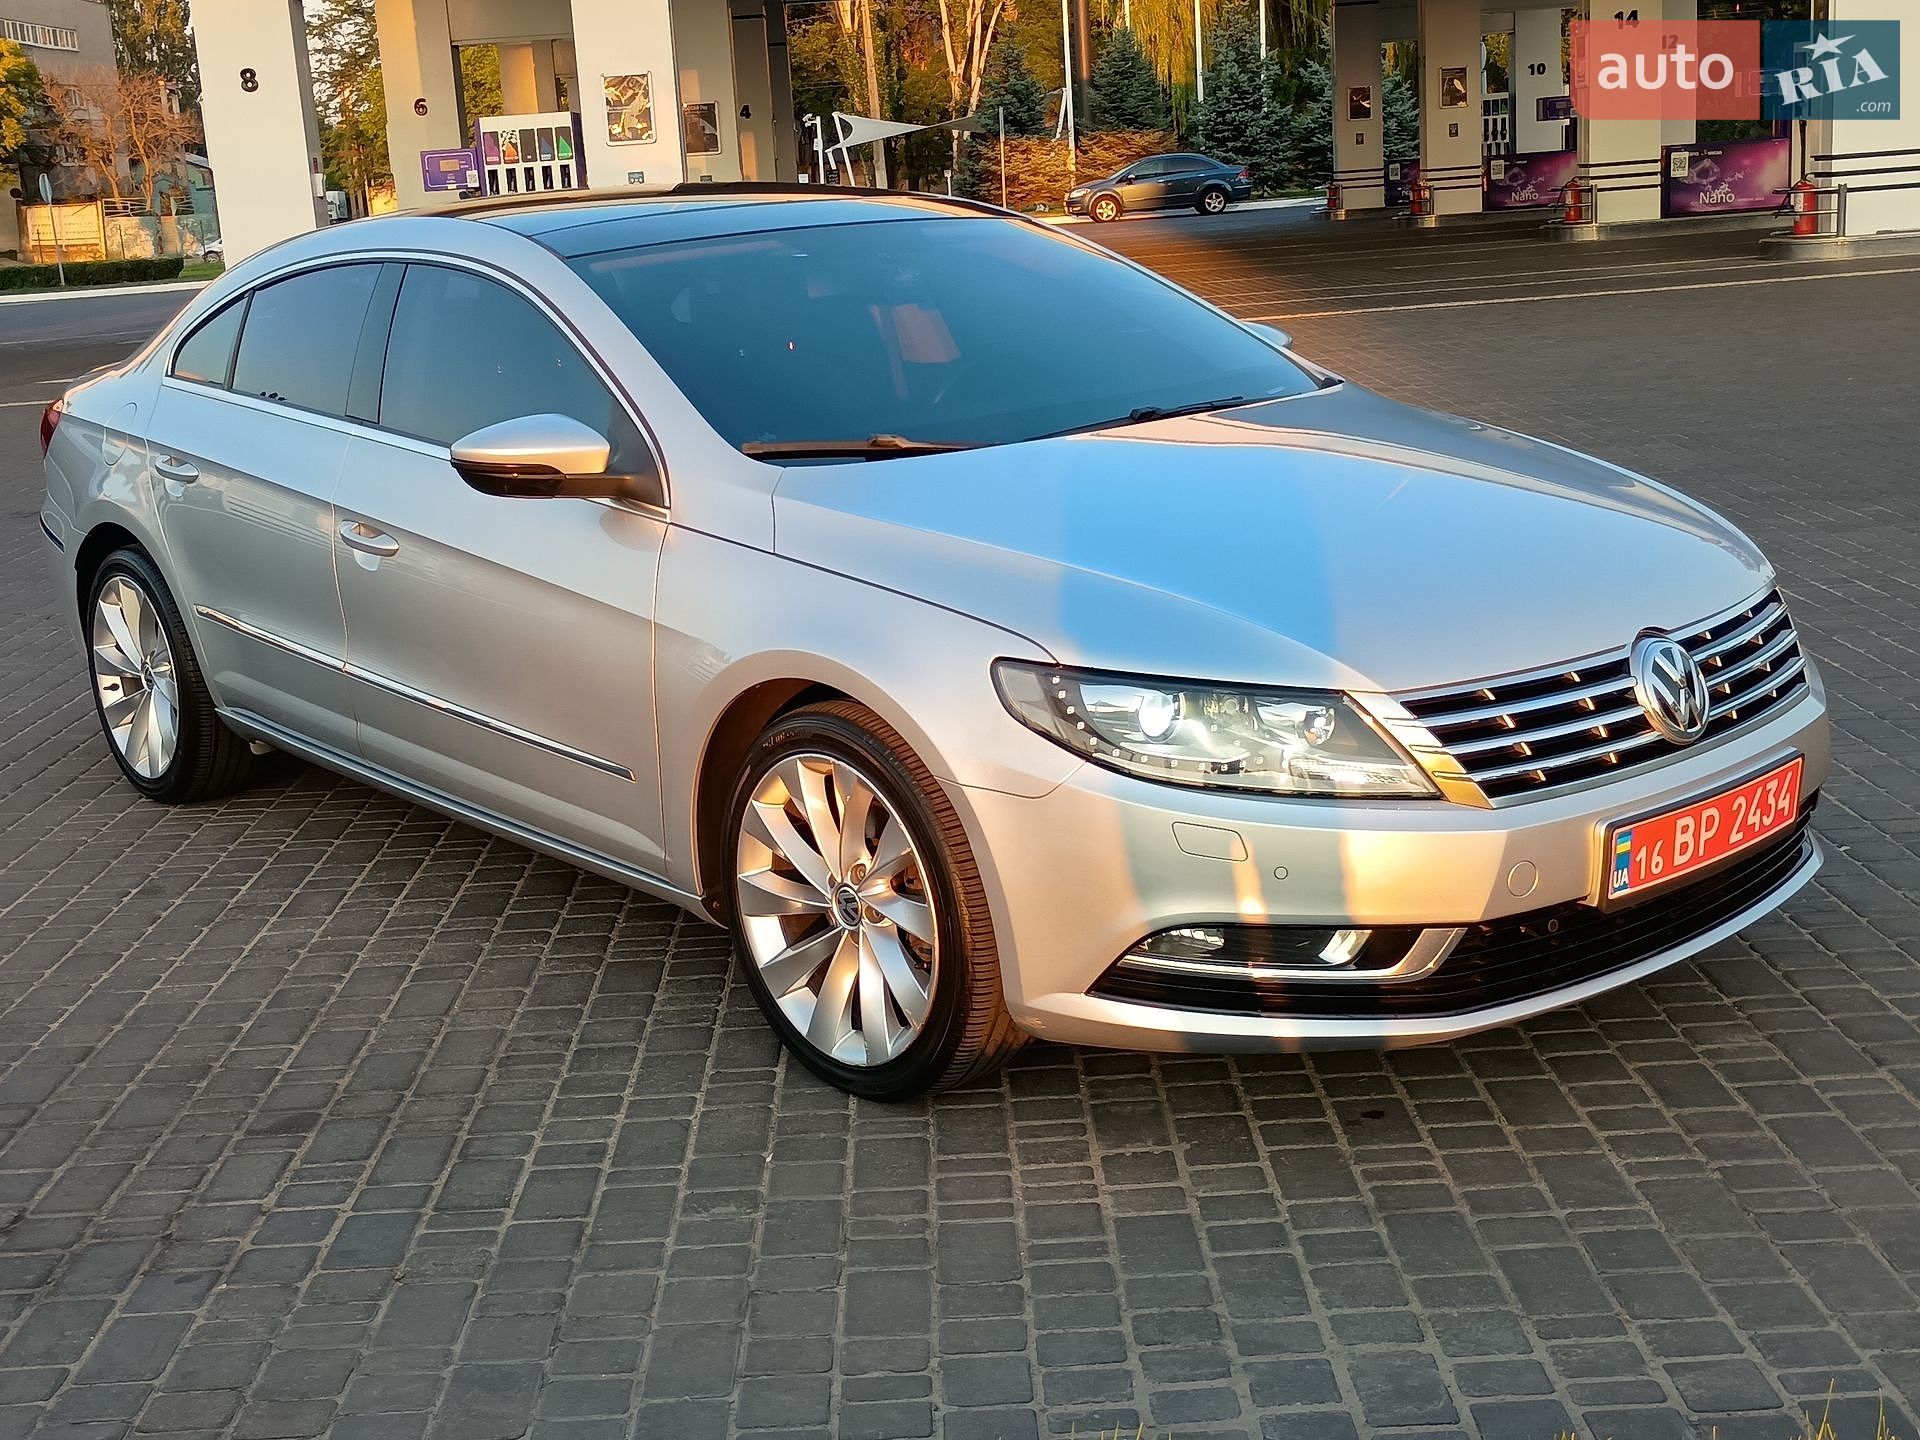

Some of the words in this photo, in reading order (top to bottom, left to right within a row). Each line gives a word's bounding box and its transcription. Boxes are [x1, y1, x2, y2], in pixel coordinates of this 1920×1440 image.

[1614, 9, 1640, 30] 14
[1527, 63, 1547, 76] 10
[239, 67, 259, 92] 8
[413, 97, 428, 116] 6
[739, 104, 752, 119] 4
[1511, 191, 1540, 202] Nano
[1699, 190, 1736, 204] Nano
[1641, 640, 1705, 734] VW
[1612, 868, 1630, 888] UA
[1634, 838, 1665, 881] 16
[1672, 806, 1721, 868] BP
[1728, 769, 1793, 845] 2434
